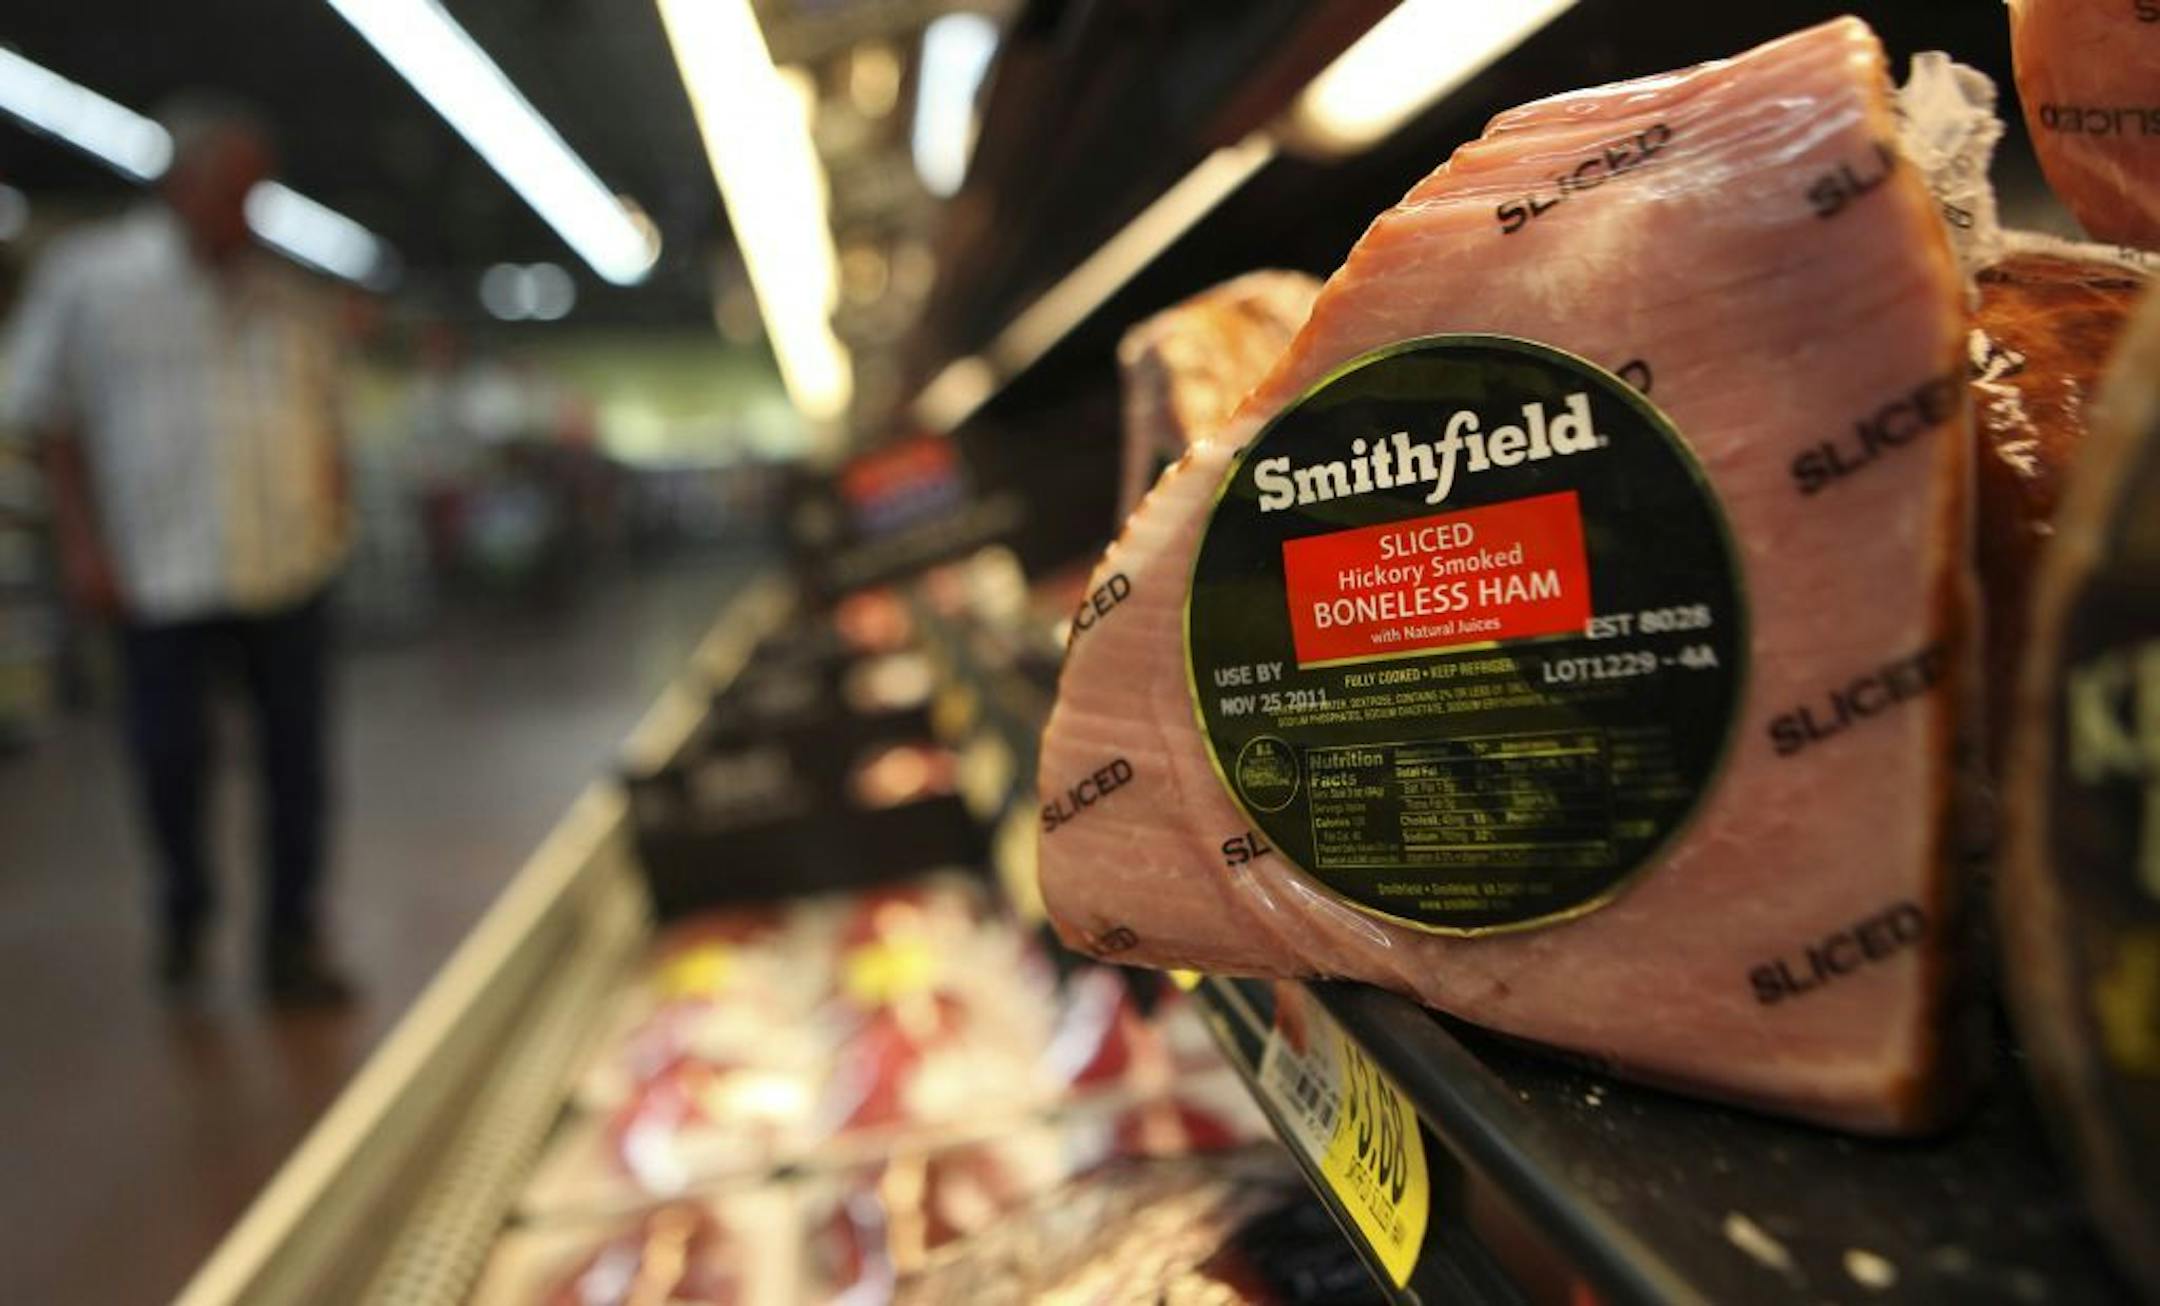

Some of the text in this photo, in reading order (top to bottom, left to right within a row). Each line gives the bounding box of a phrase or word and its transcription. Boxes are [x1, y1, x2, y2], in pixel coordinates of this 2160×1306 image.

[1497, 123, 1671, 234] SLICED
[1254, 392, 1600, 511] Smithfield
[1379, 522, 1474, 560] SLICED
[1338, 543, 1523, 591] Hickory Smoked
[1314, 569, 1561, 629] BONELESS HAM
[1371, 616, 1501, 644] with Natural Juices
[1585, 614, 1633, 639] EST
[1214, 661, 1283, 687] USE BY
[1345, 672, 1376, 689] FULLY
[1379, 667, 1421, 685] COOKED
[1543, 650, 1657, 683] LOT1229
[1220, 695, 1256, 717] NOV
[1309, 751, 1384, 769] Nutrition
[1042, 758, 1133, 833] SLICED
[1311, 772, 1358, 788] Facts
[1751, 902, 1924, 1005] SLICED
